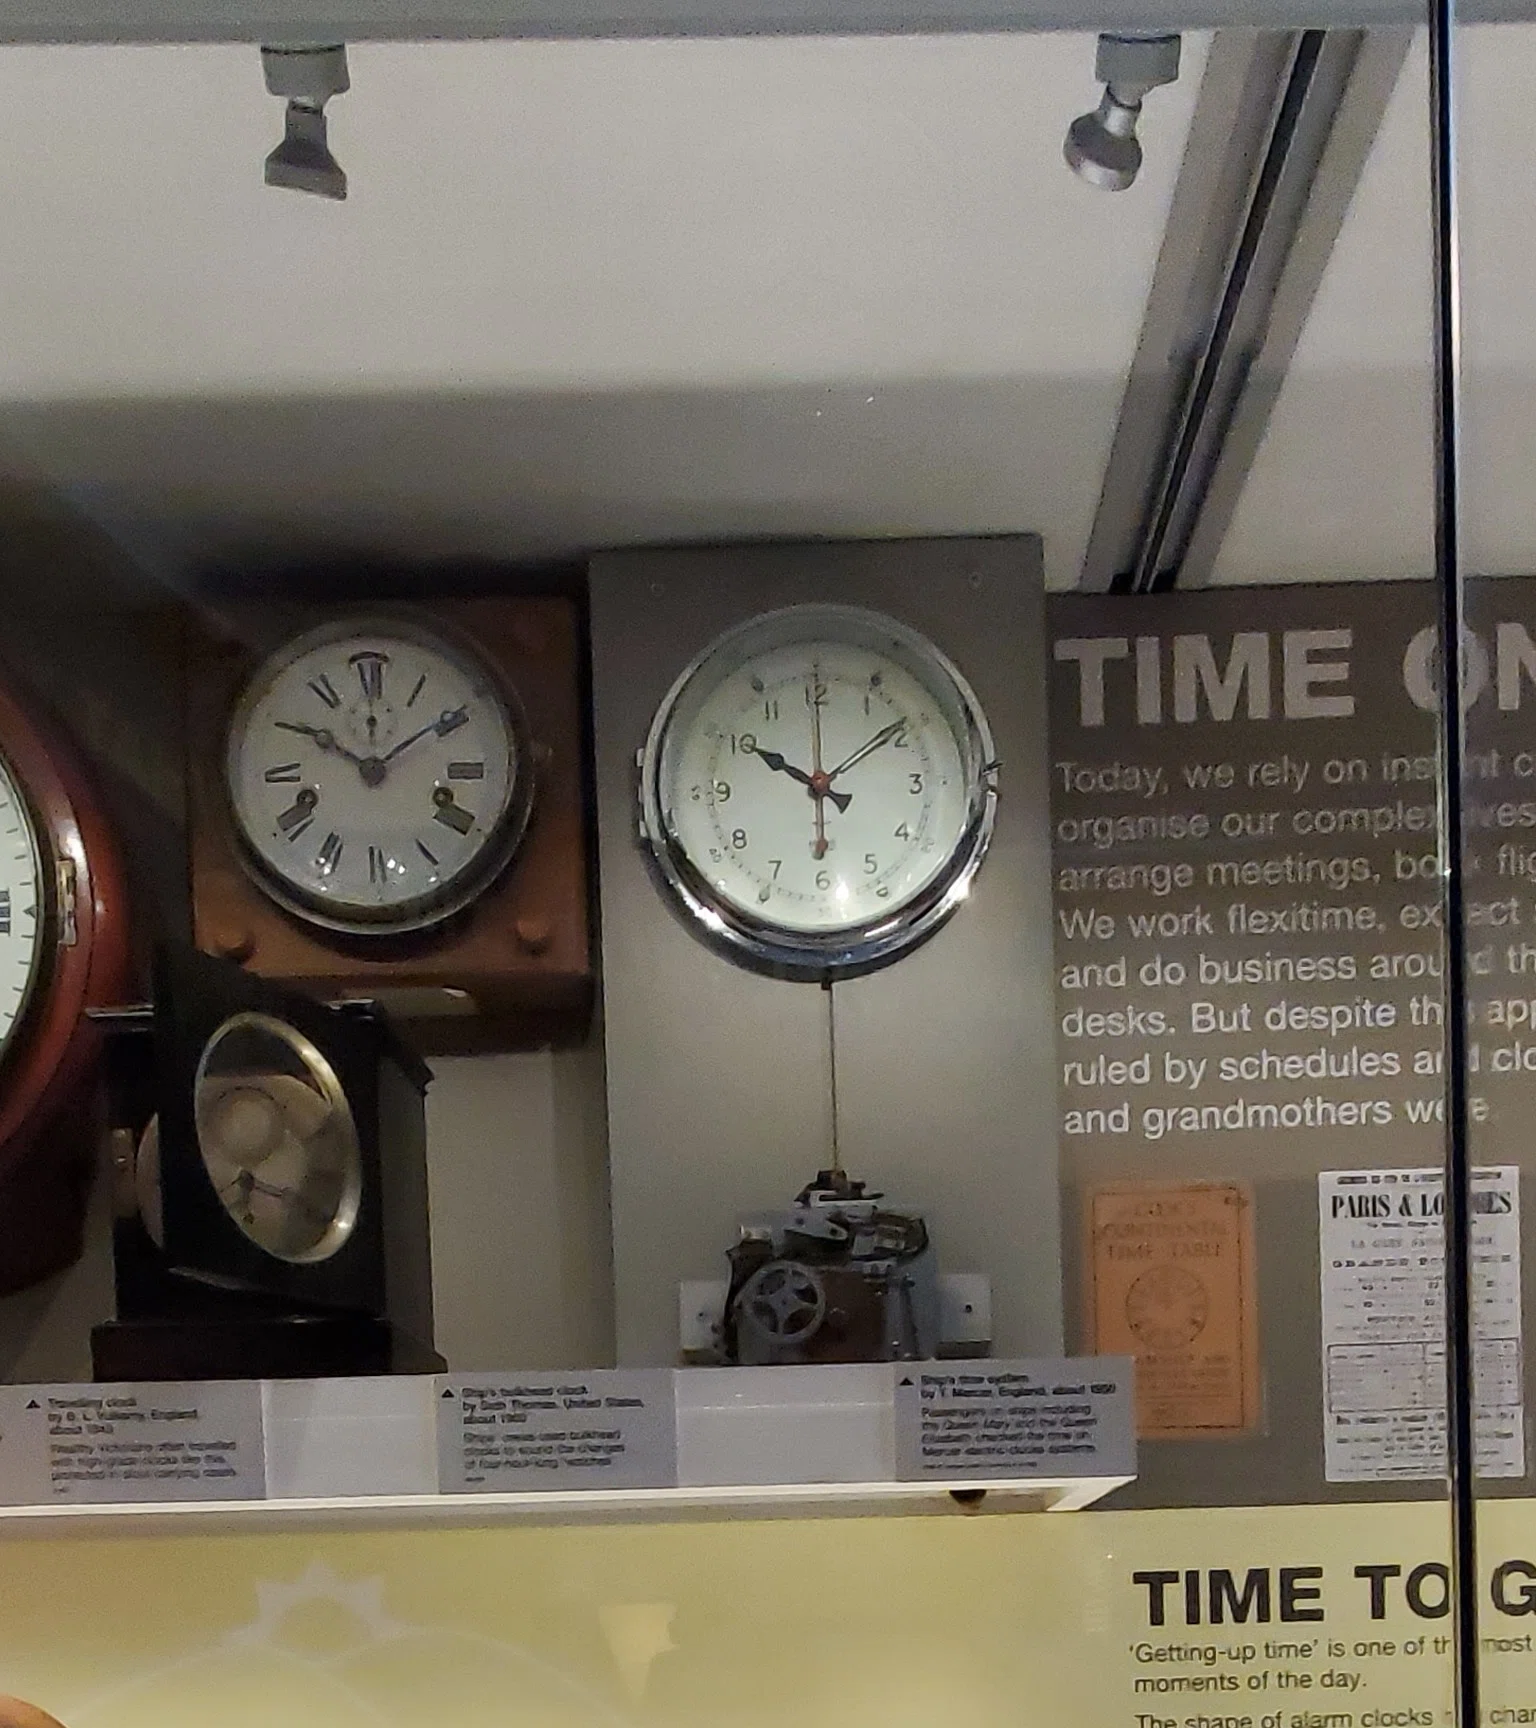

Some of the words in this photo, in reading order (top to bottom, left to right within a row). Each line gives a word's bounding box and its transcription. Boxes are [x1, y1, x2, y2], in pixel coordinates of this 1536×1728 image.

[1054, 628, 1356, 726] TIME
[1059, 908, 1115, 940] We
[1128, 904, 1214, 937] work
[1228, 901, 1386, 934] flexitime,
[1061, 956, 1127, 989] and
[1139, 953, 1187, 985] do
[1199, 950, 1357, 984] business
[1062, 1006, 1176, 1036] desks.
[1191, 1003, 1253, 1034] But
[1265, 996, 1397, 1036] despite
[1064, 1053, 1151, 1086] ruled
[1164, 1052, 1207, 1089] by
[1219, 1046, 1402, 1081] schedules
[1064, 1103, 1130, 1135] and
[1142, 1098, 1393, 1139] grandmothers
[1332, 1194, 1390, 1218] PARIS
[1133, 1566, 1325, 1625] TIME
[1354, 1561, 1453, 1621] TO
[1327, 1640, 1346, 1658] is
[1353, 1639, 1396, 1657] one
[1403, 1636, 1426, 1655] of
[1134, 1673, 1239, 1693] moments
[1247, 1671, 1271, 1690] of
[1276, 1671, 1313, 1689] the
[1320, 1669, 1367, 1692] day.
[1360, 1708, 1433, 1727] clocks
